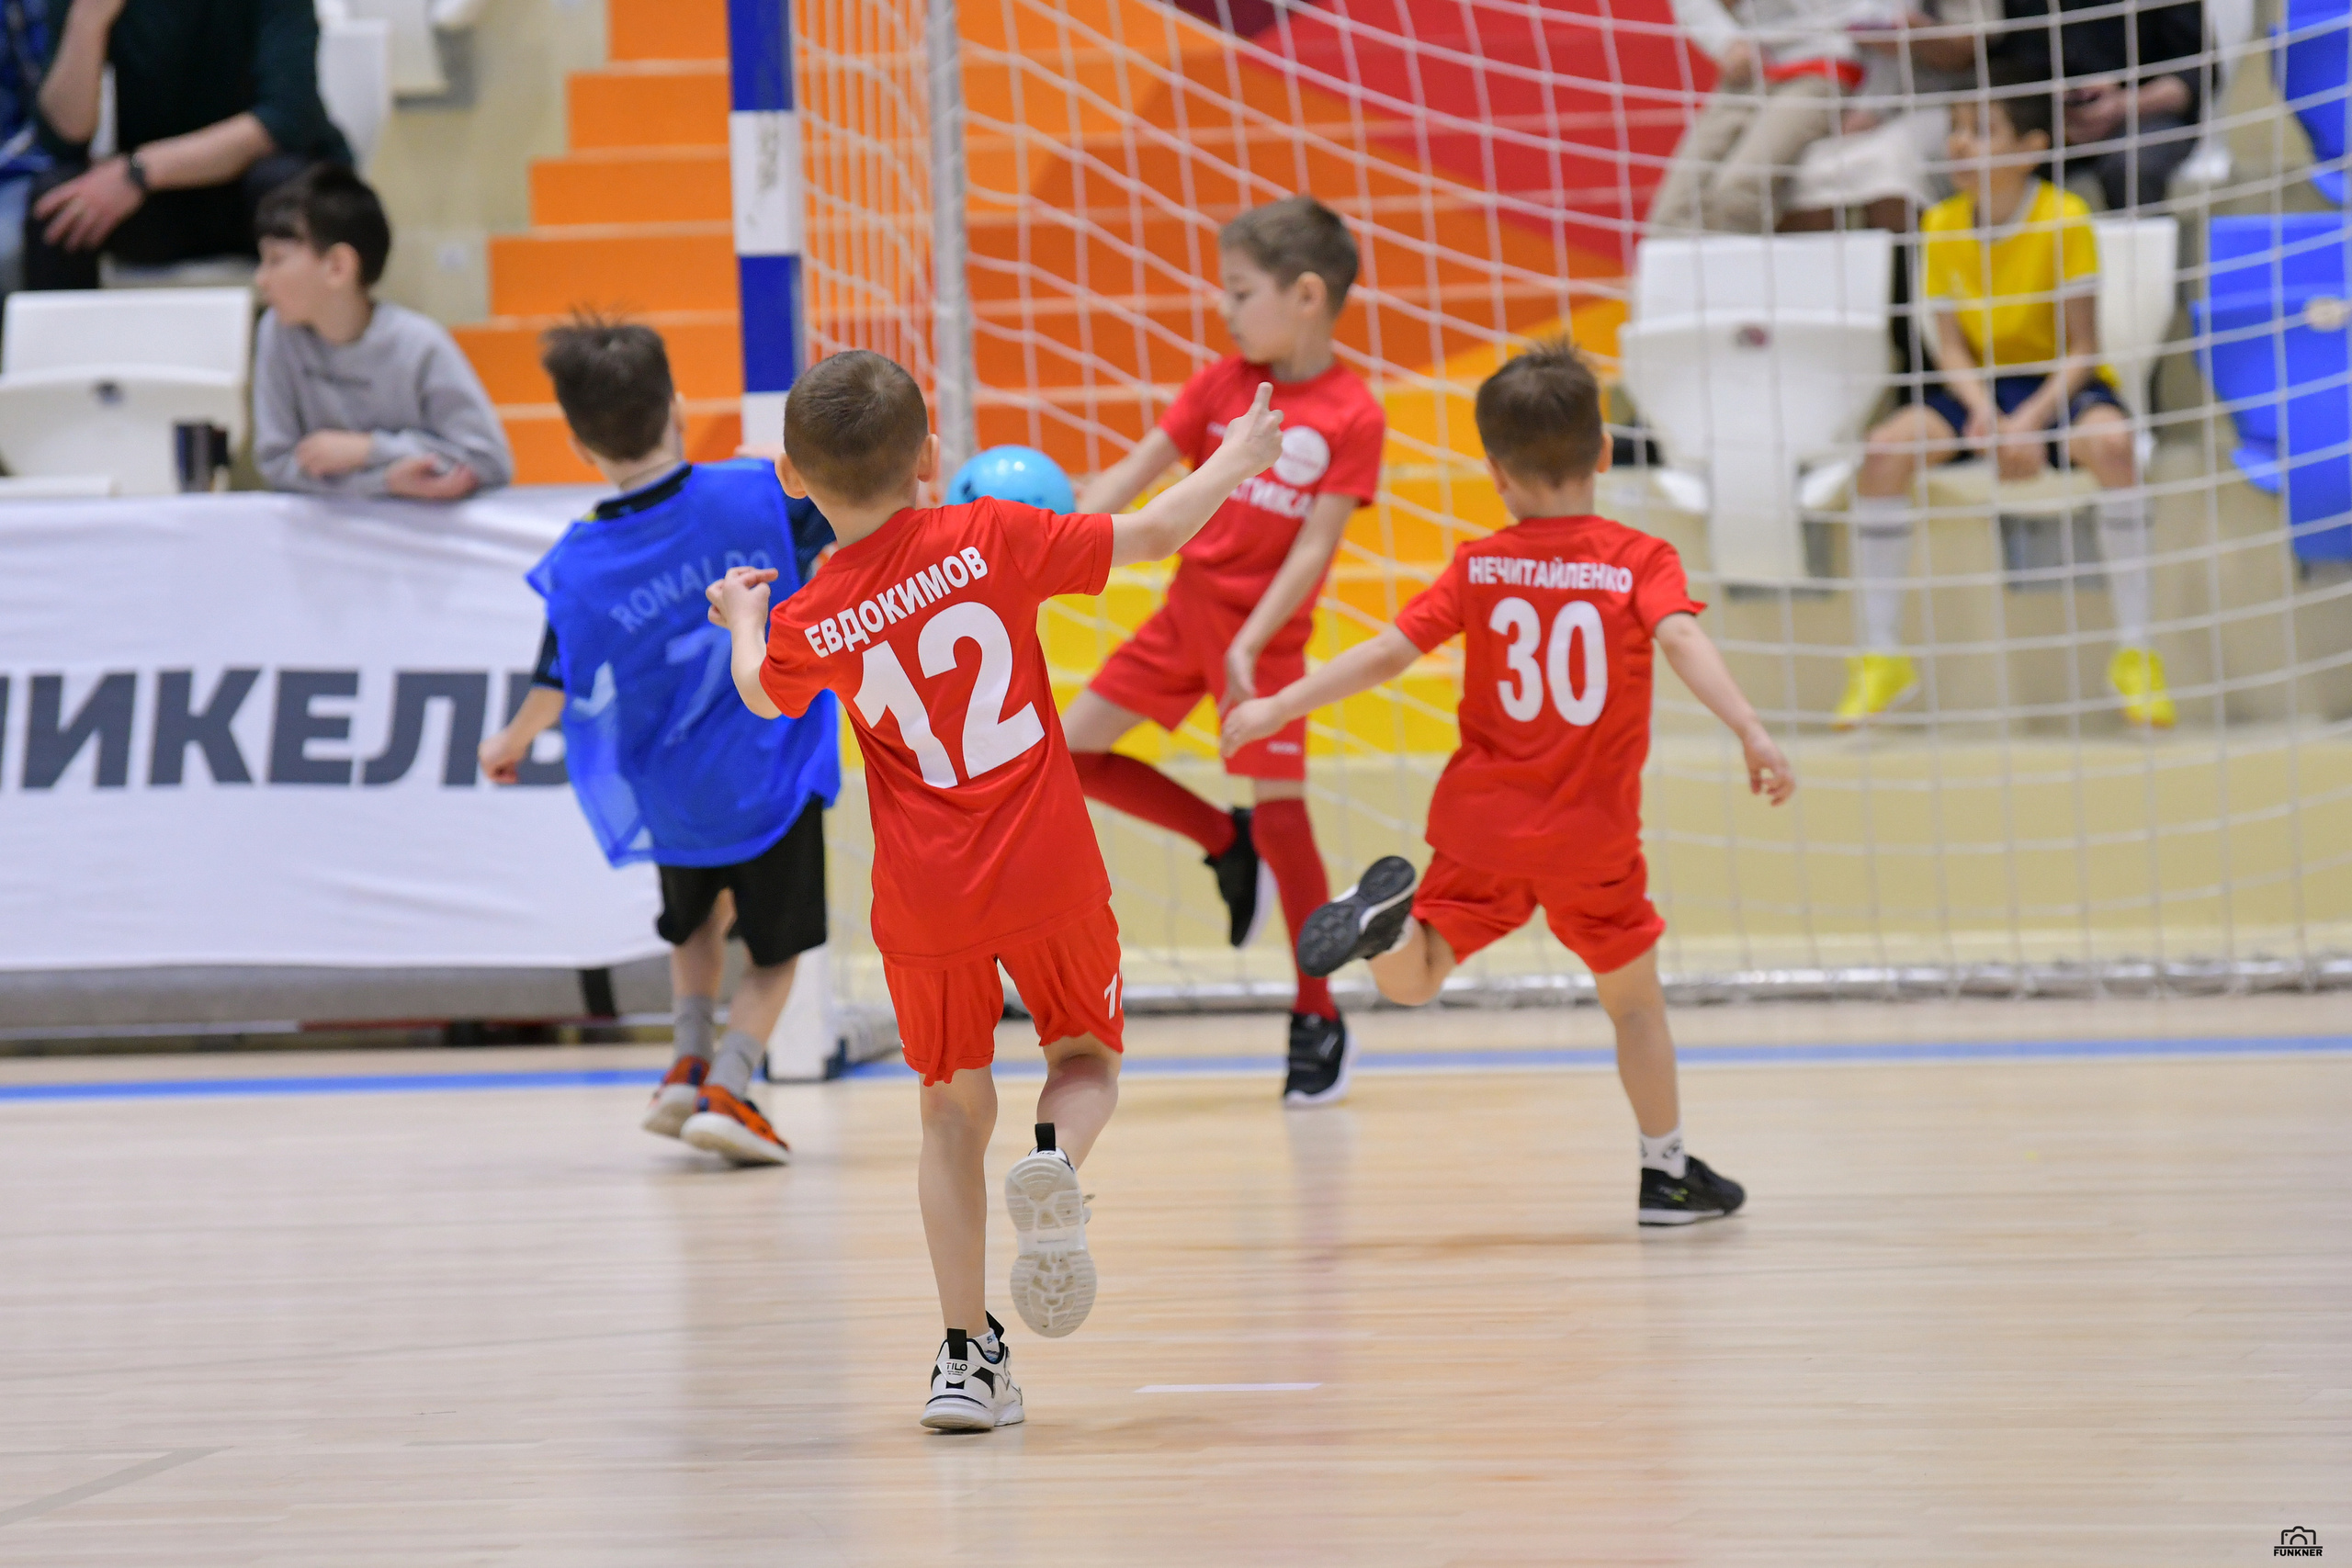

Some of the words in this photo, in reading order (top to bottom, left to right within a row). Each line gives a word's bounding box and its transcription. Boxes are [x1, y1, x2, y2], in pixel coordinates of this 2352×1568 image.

[804, 547, 988, 659] ЕВДОКИМОВ
[1468, 556, 1634, 593] НЕЧИТАЙЛЕНКО
[665, 626, 732, 746] 7
[853, 601, 1046, 789] 12
[1488, 596, 1608, 728] 30
[0, 668, 571, 790] ИКЕЛ
[1103, 972, 1123, 1021] 1
